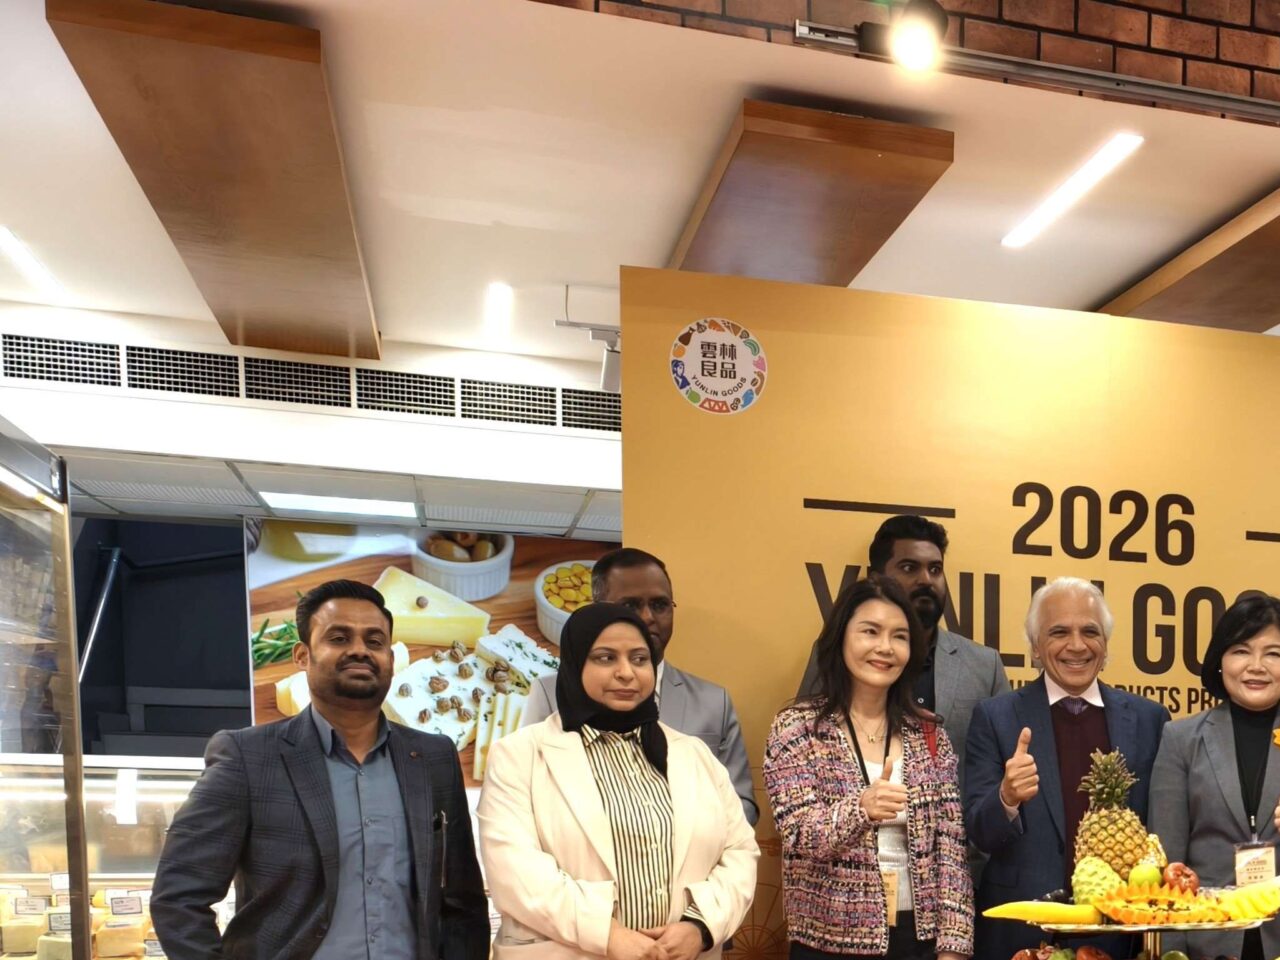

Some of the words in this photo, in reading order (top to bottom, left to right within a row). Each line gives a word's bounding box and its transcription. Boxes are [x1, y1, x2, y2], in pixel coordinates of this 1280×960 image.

[700, 341, 737, 360] 雲林
[701, 361, 736, 379] 良品
[691, 375, 718, 396] YUNLIN
[721, 377, 747, 396] GOODS
[1011, 482, 1196, 565] 2026
